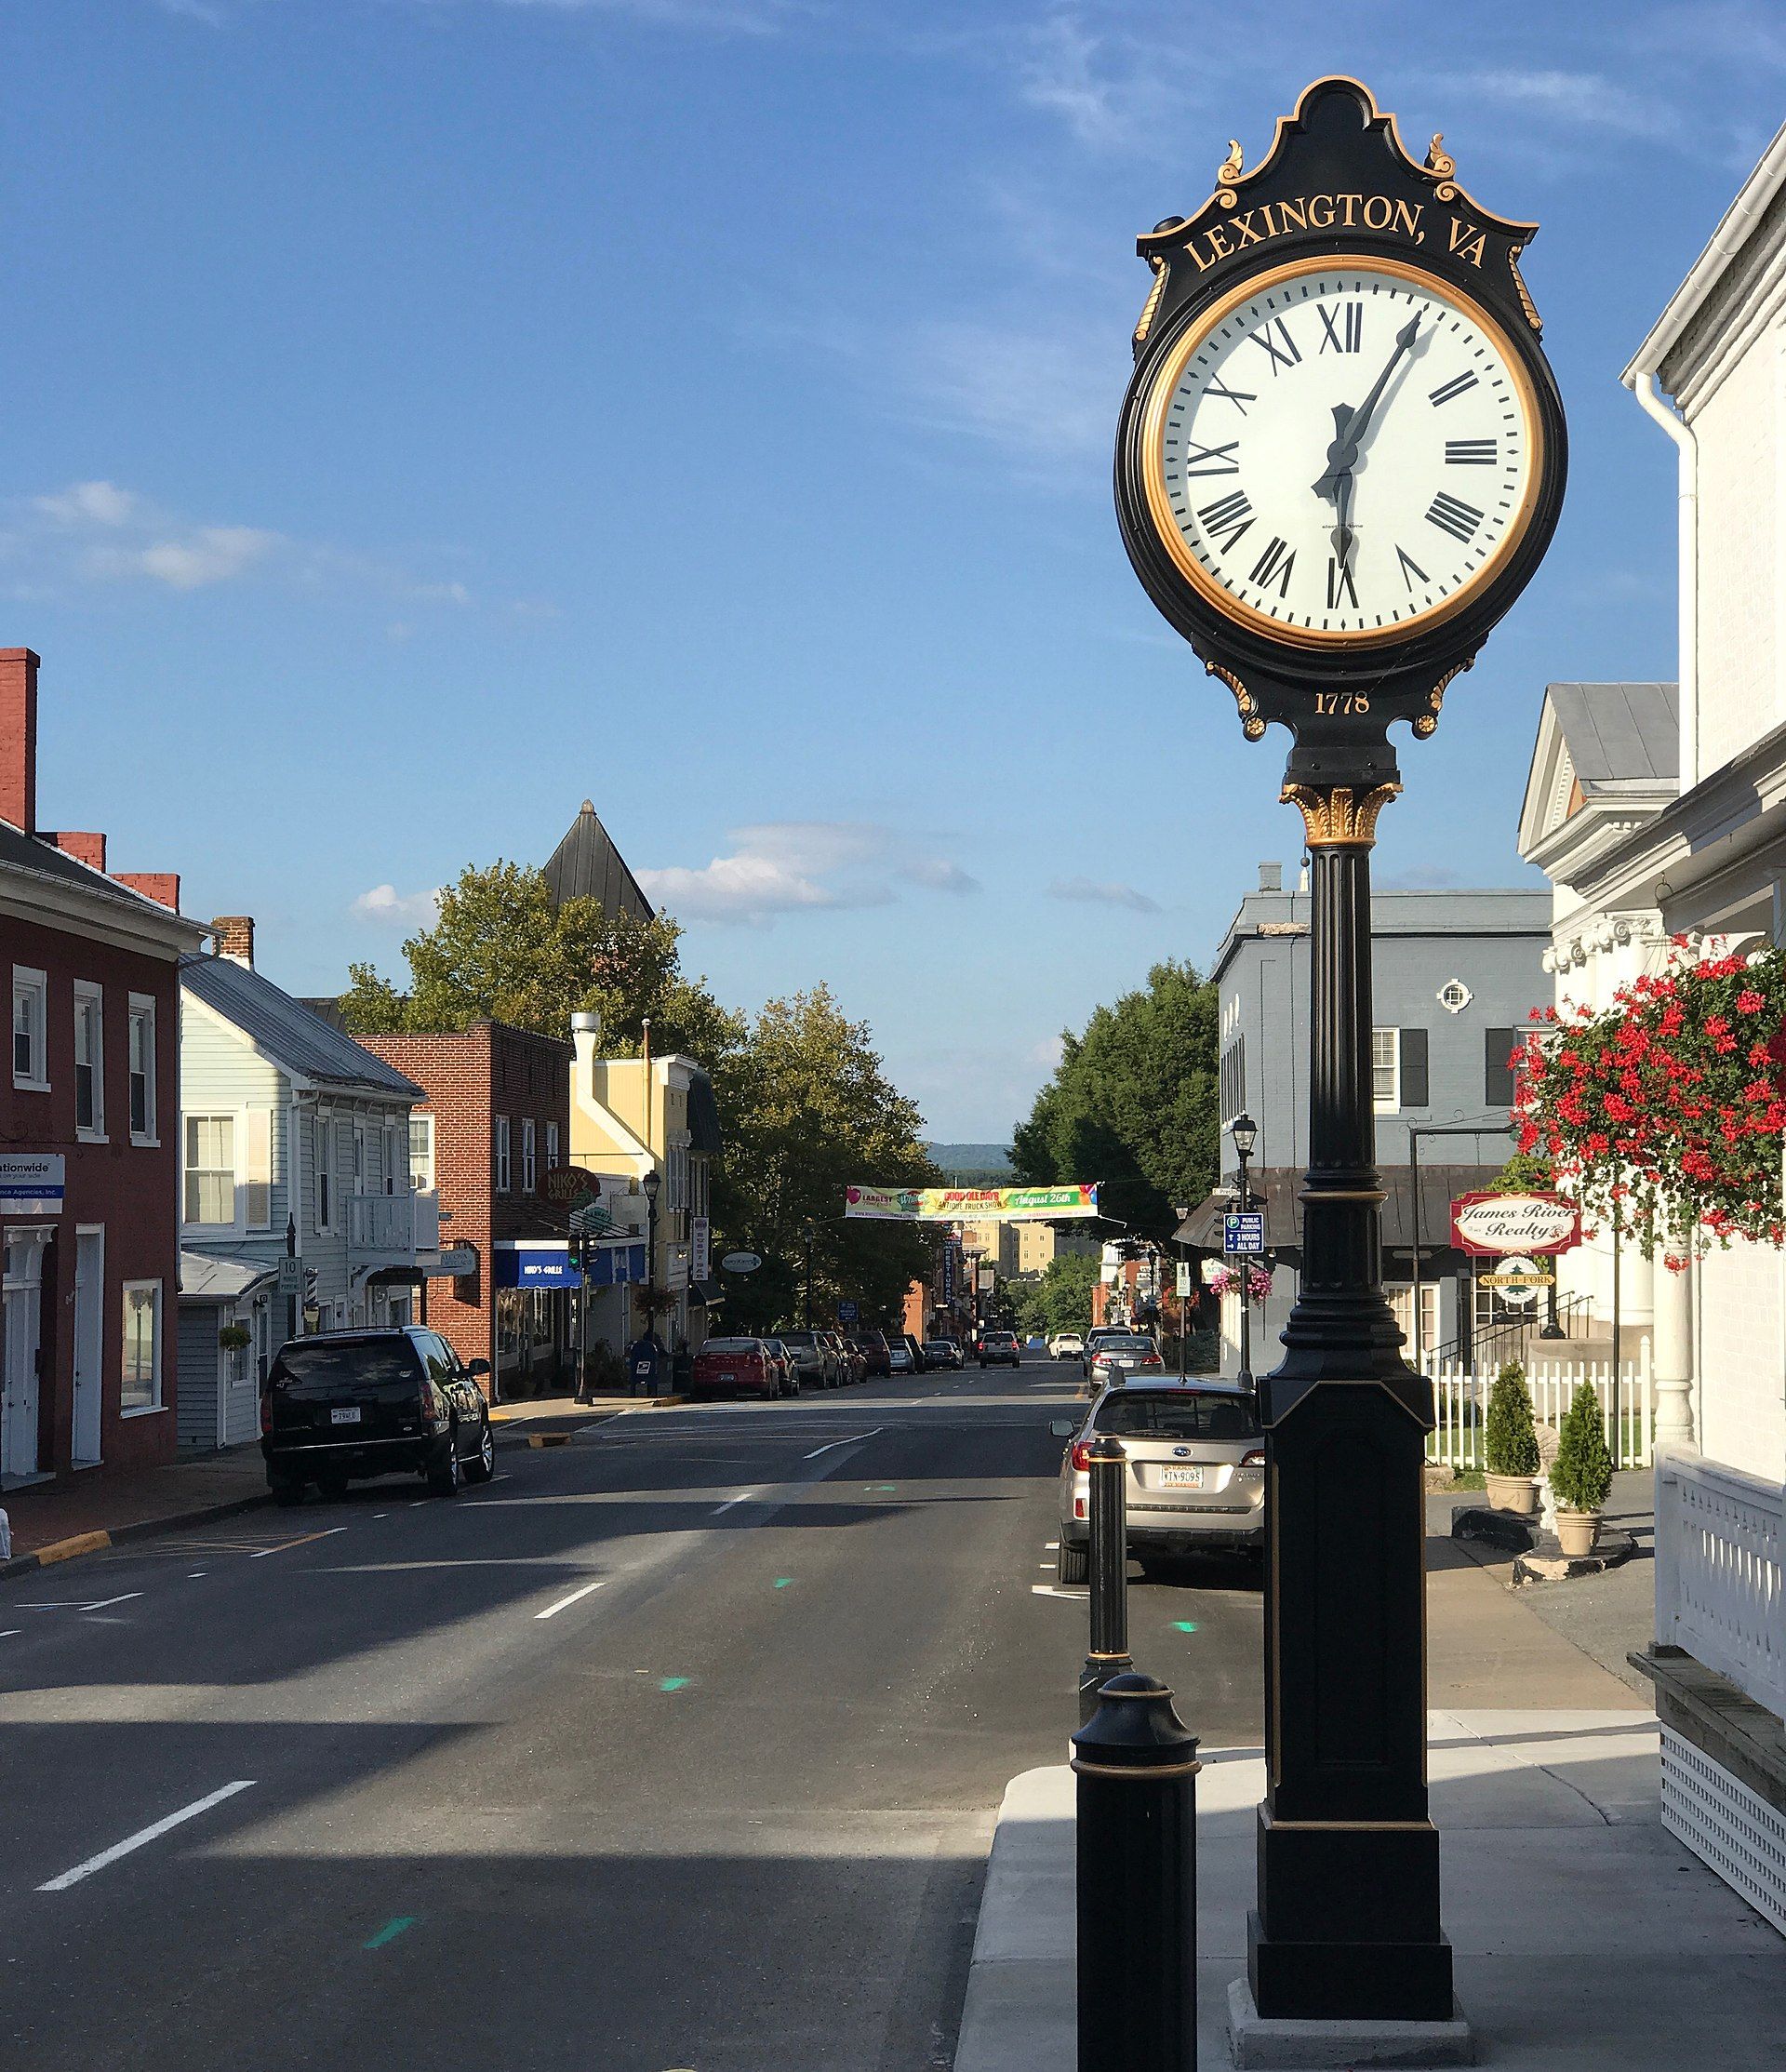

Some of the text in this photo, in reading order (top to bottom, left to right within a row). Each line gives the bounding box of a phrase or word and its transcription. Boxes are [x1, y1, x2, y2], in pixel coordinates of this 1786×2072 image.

[1183, 194, 1488, 273] LEXINGTON, VA
[1316, 302, 1363, 354] XII
[1248, 316, 1303, 377] XI
[1202, 372, 1258, 417] X
[1187, 440, 1240, 477] IX
[1445, 439, 1498, 465] III
[1197, 489, 1259, 555] VIII
[1424, 491, 1486, 544] IIII
[1248, 536, 1298, 598] VII
[1394, 542, 1432, 593] V
[1327, 556, 1360, 609] VI
[1314, 690, 1370, 715] 1778
[548, 1173, 589, 1190] NIKO'S
[938, 1200, 1002, 1210] ANTIQUE TRUCK SHOW
[944, 1192, 999, 1201] GOOD OLE DAYS
[1015, 1193, 1071, 1207] August 26th
[1456, 1203, 1576, 1224] James River
[1236, 1233, 1260, 1241] 3 HOURS
[1486, 1222, 1549, 1240] Realty
[1237, 1242, 1260, 1250] ALL DAY
[285, 1261, 296, 1274] 10
[1523, 1275, 1552, 1284] FORK
